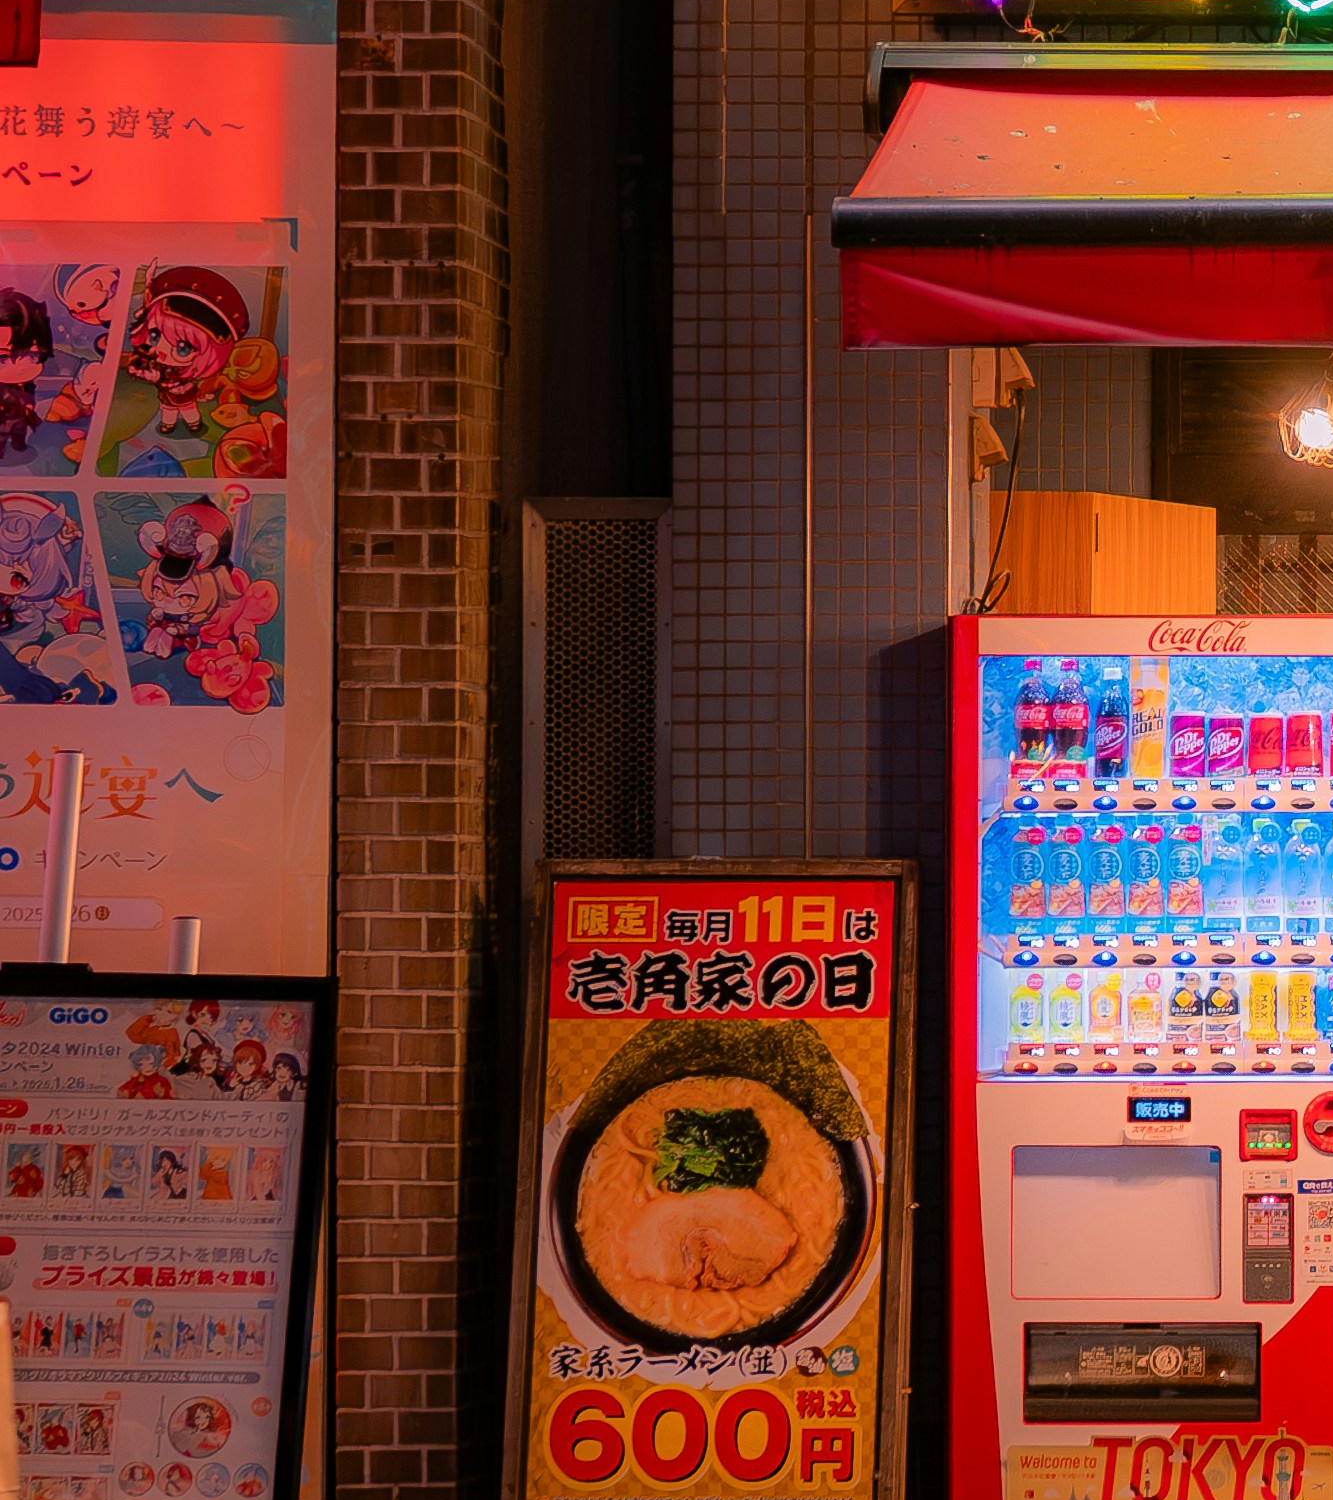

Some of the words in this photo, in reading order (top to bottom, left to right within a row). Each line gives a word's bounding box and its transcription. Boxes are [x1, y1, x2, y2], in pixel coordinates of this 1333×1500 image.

[1148, 620, 1247, 652] Coca-Cola
[1132, 707, 1162, 724] REAL
[1132, 720, 1163, 736] GOLD
[576, 903, 648, 936] 限定
[567, 950, 876, 1014] 壱角家の日
[49, 1007, 109, 1025] GiGO
[1135, 1102, 1185, 1118] 販売中
[549, 1345, 788, 1380] 家系ラーメン(並)
[796, 1389, 857, 1418] 税込
[1020, 1454, 1079, 1469] Welcome
[1083, 1455, 1097, 1469] to
